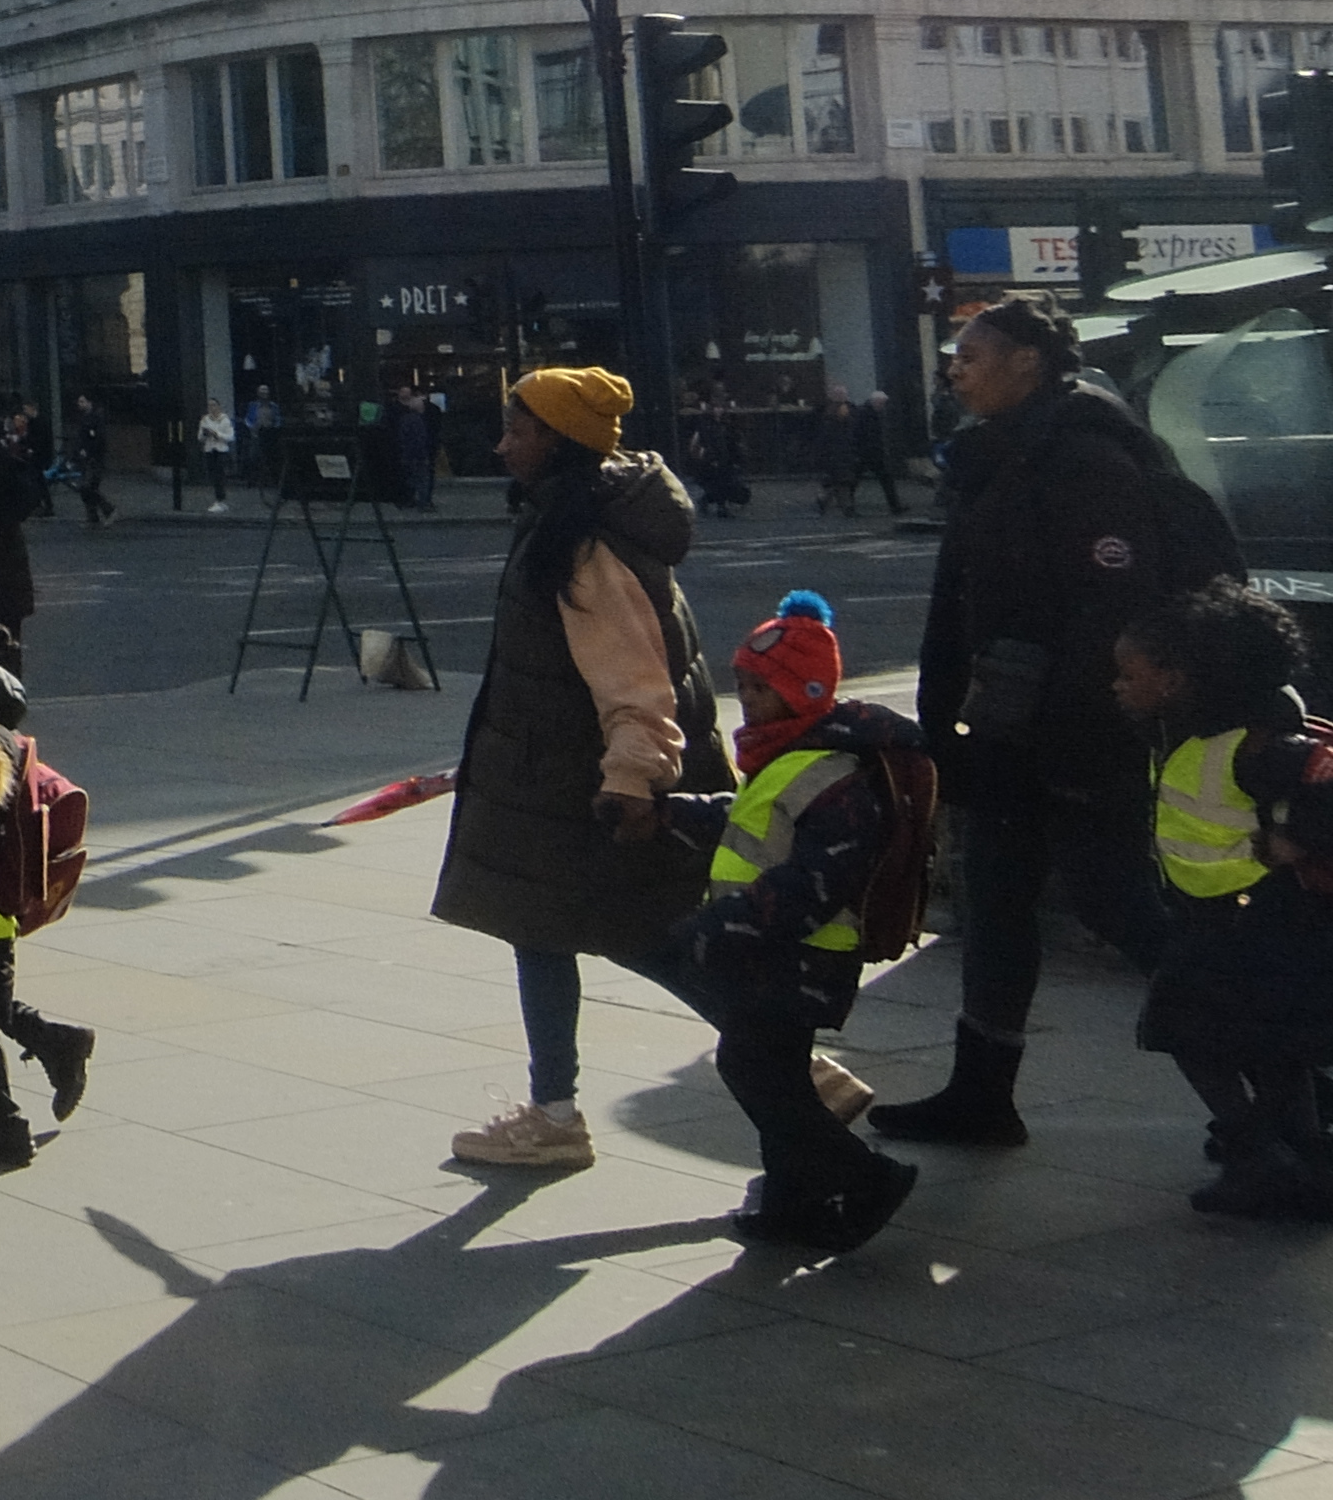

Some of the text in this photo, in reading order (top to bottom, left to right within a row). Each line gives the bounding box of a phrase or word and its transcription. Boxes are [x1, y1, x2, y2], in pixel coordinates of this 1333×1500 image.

[1030, 233, 1237, 267] TES express
[400, 285, 448, 314] PRET
